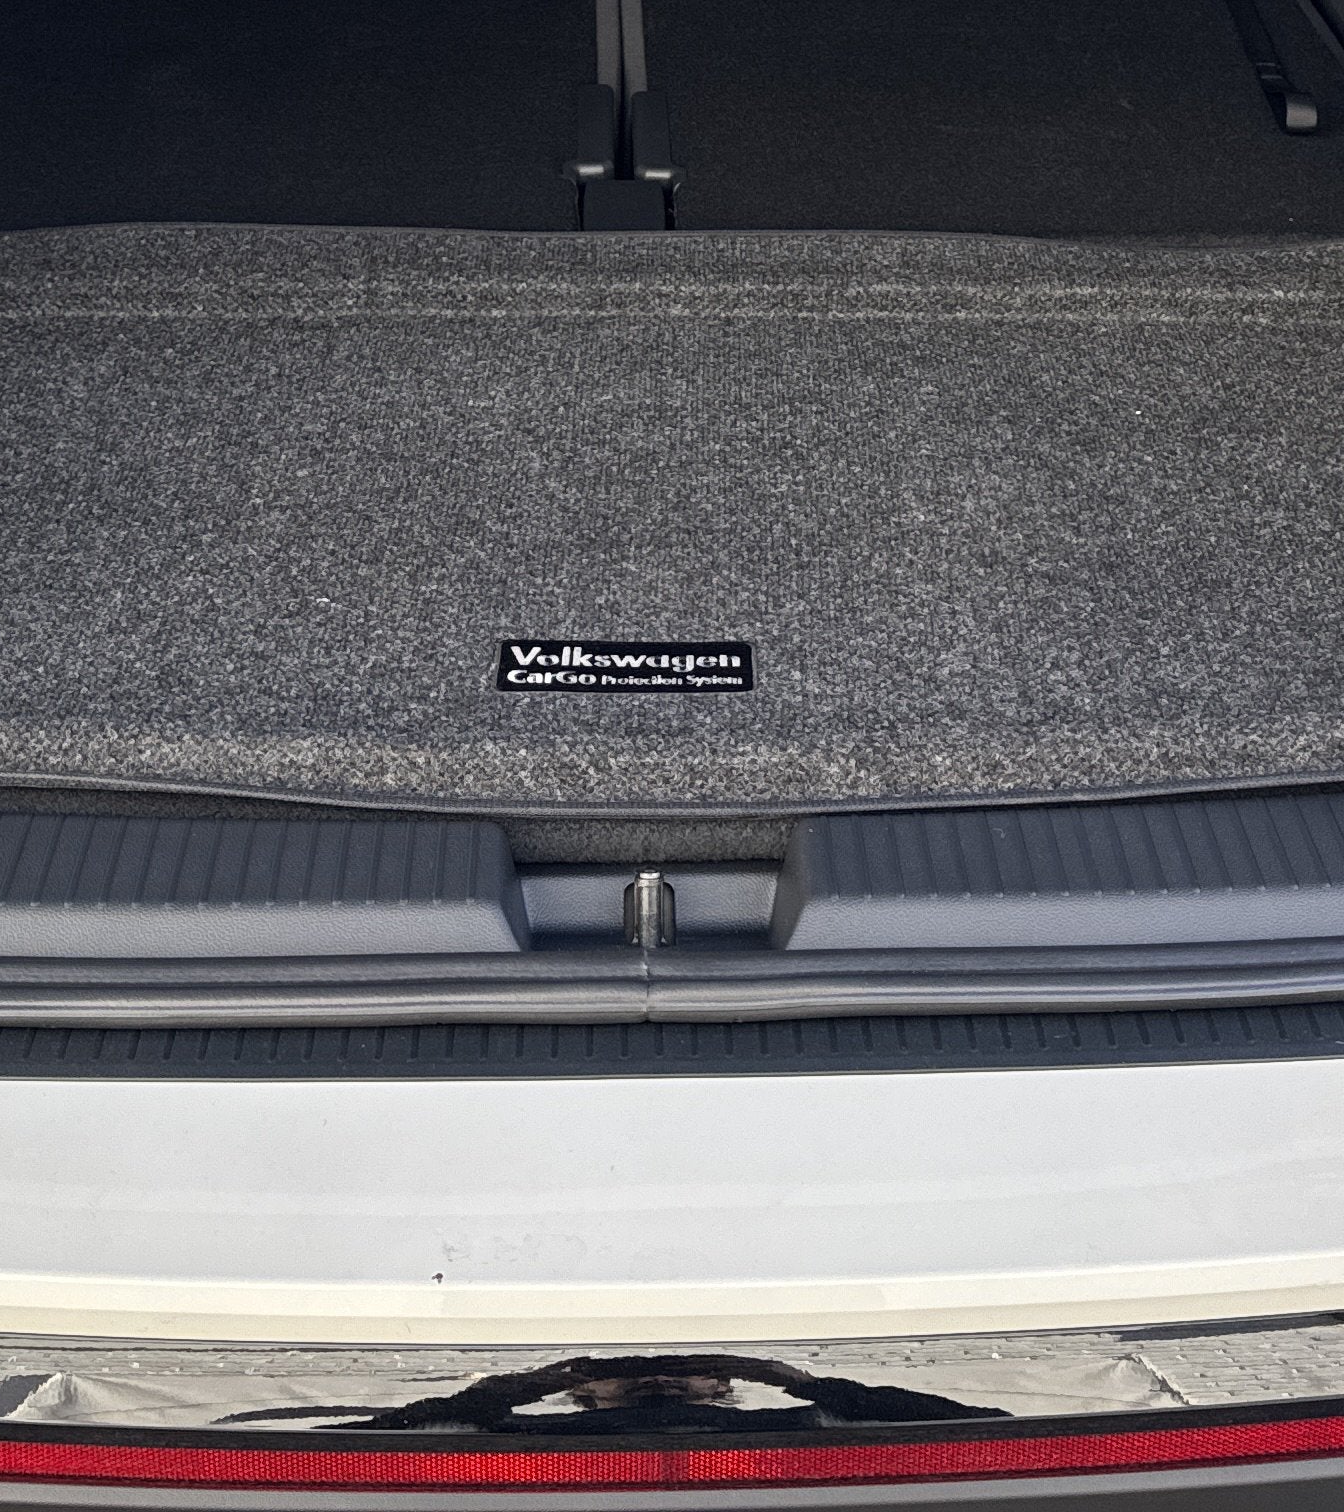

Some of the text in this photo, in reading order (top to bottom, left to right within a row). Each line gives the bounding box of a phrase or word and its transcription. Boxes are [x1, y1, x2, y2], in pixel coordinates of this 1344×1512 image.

[510, 645, 742, 673] Volkswagen
[506, 669, 597, 686] CarGo
[685, 674, 743, 687] System
